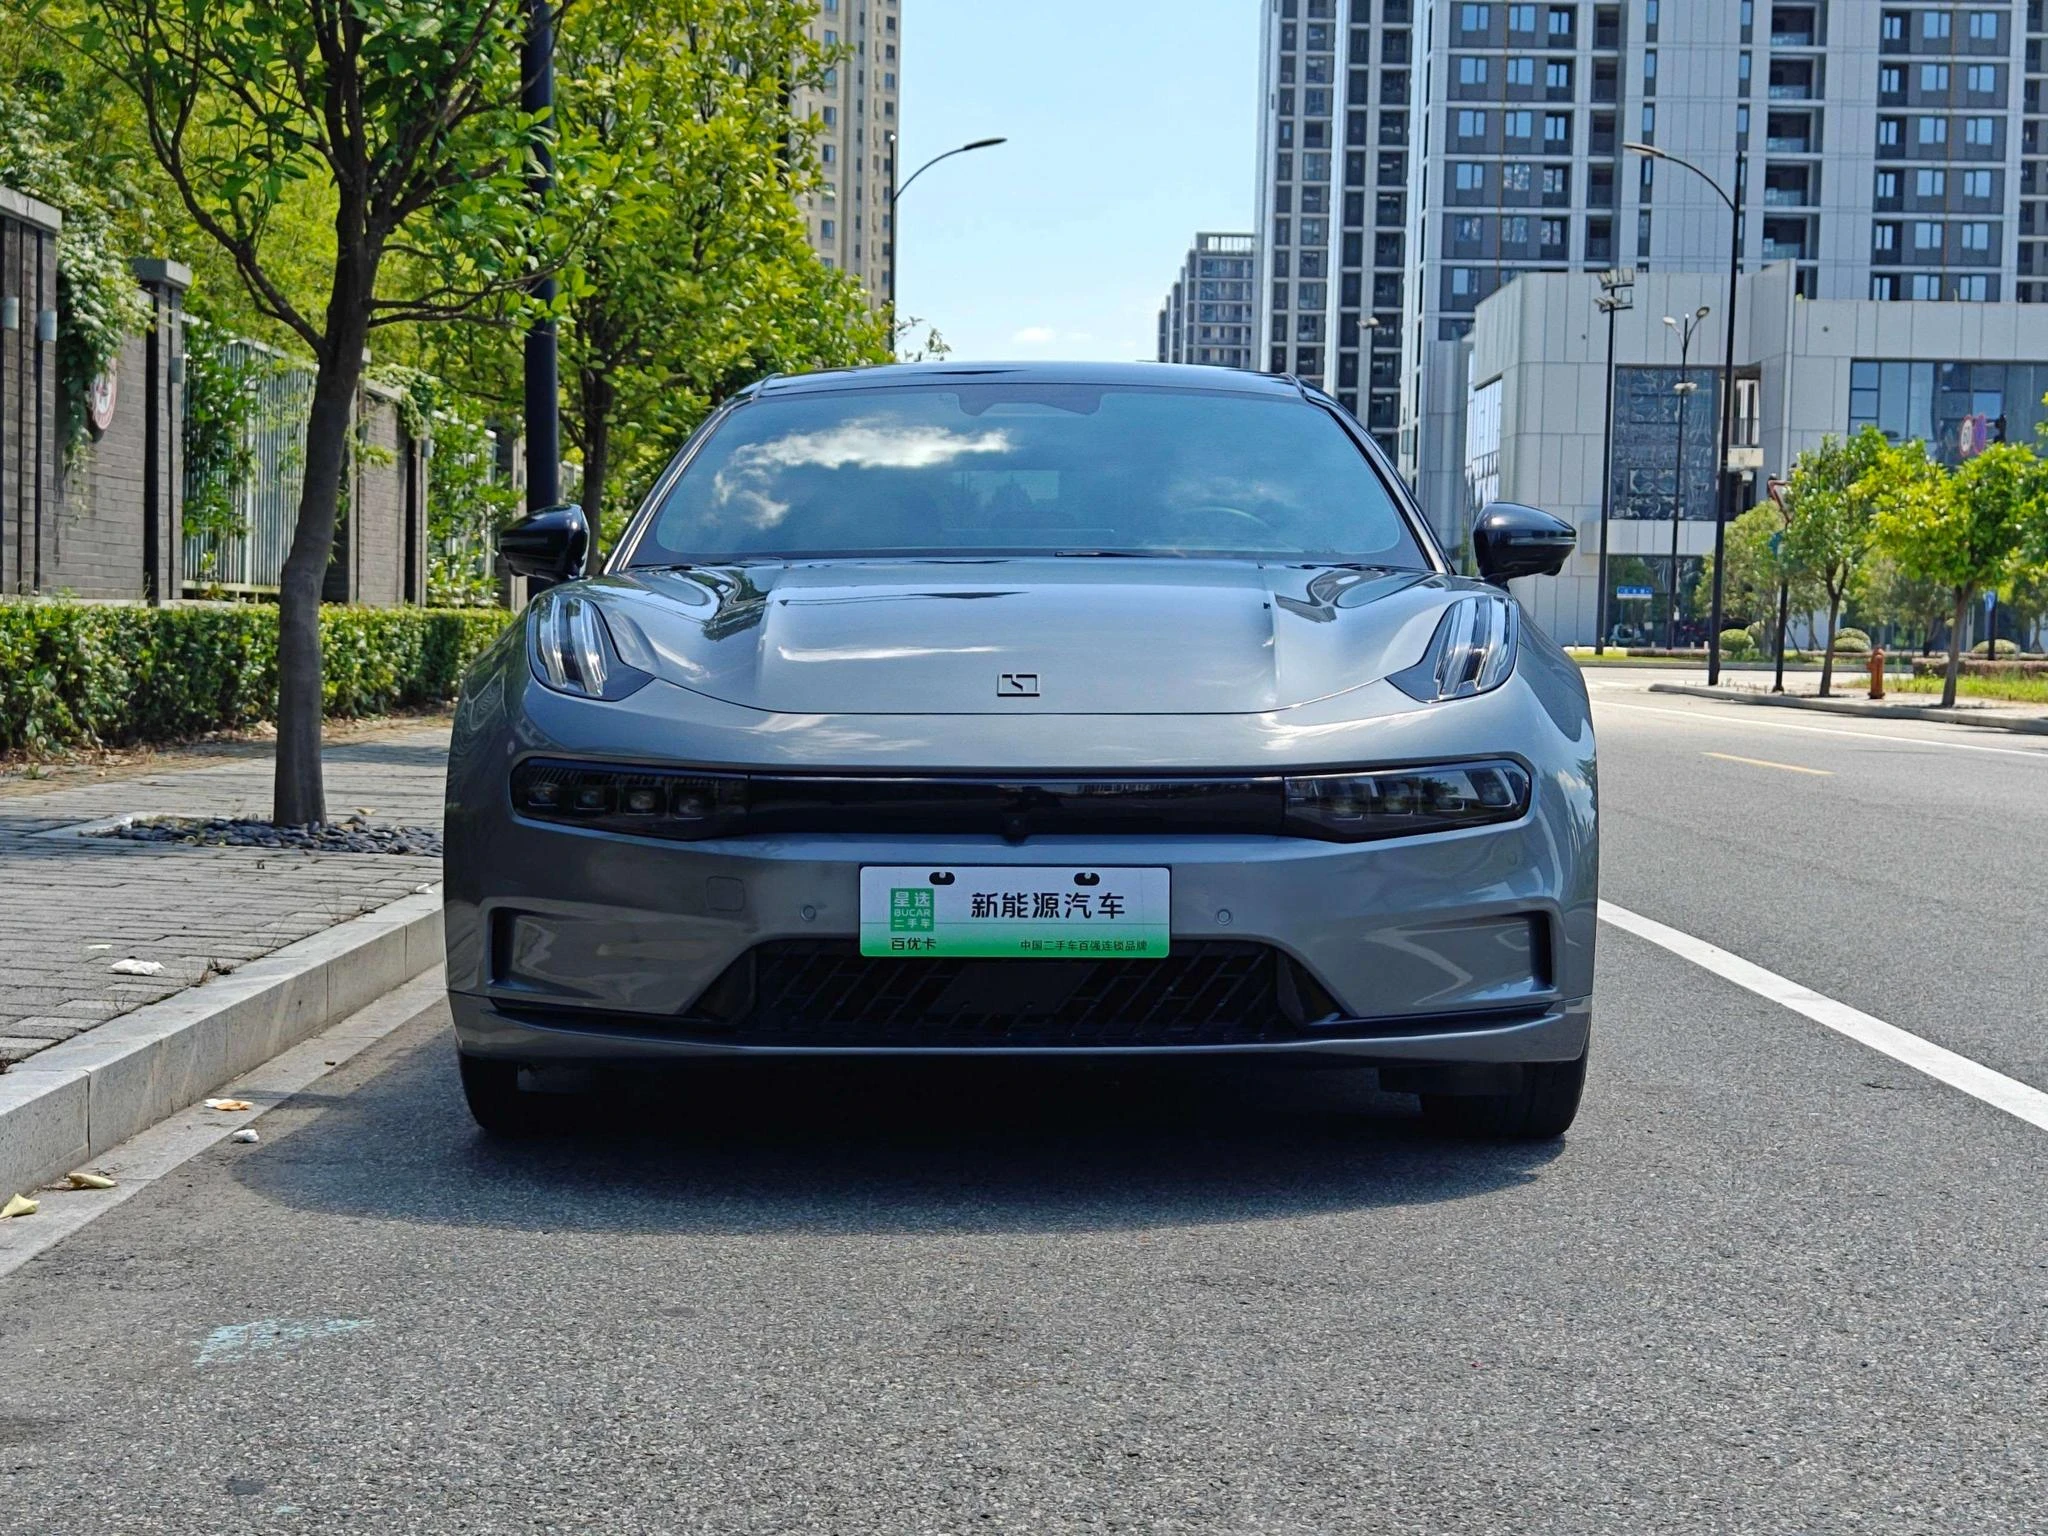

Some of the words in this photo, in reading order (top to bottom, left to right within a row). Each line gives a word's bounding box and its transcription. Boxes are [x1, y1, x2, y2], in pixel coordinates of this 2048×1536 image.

[894, 891, 931, 907] 星选
[971, 892, 1125, 919] 新能源汽车
[894, 908, 931, 917] BUCAR
[894, 919, 931, 928] 二手车
[891, 937, 936, 950] 百优卡
[1020, 939, 1147, 951] 中国二手车百强连锁品牌
